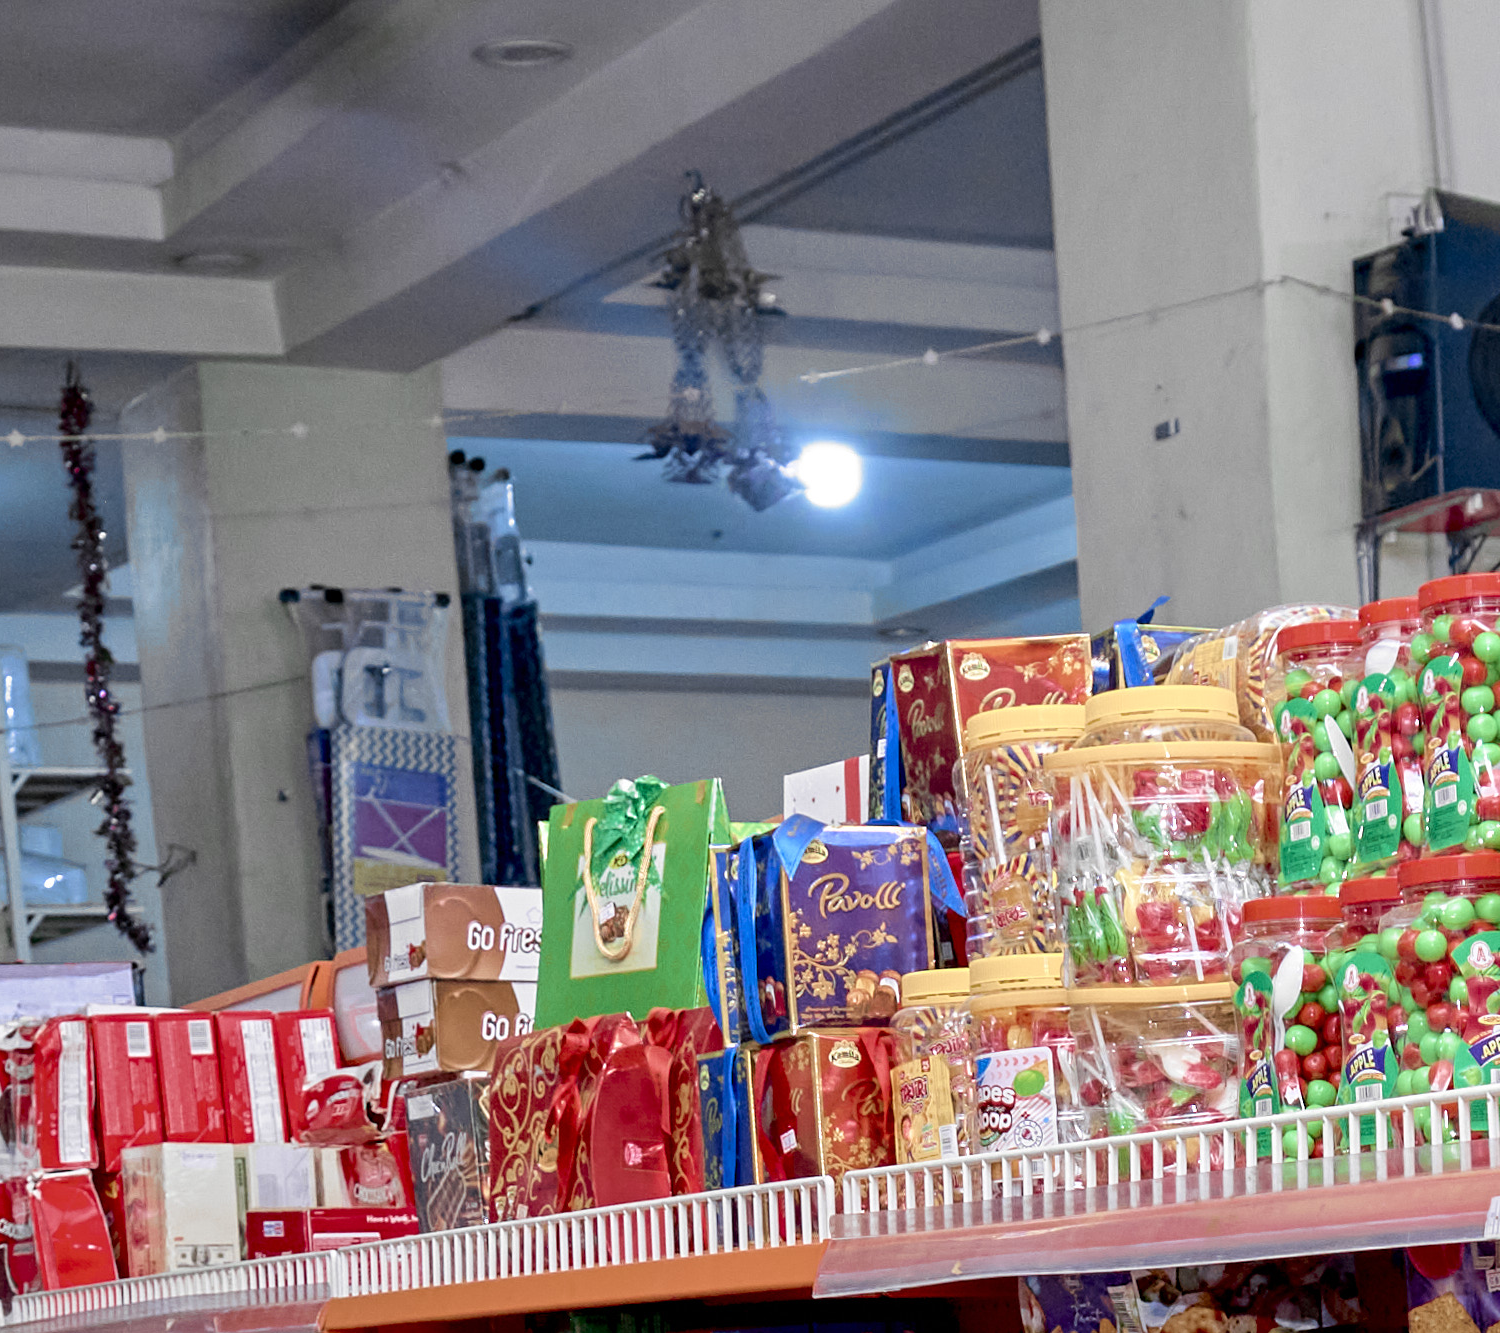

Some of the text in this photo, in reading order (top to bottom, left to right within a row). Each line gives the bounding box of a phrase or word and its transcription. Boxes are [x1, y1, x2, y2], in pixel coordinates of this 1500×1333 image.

[1362, 767, 1382, 793] APPLE
[467, 921, 495, 951] Go
[481, 1011, 509, 1041] Go
[1350, 1048, 1375, 1077] APPLE
